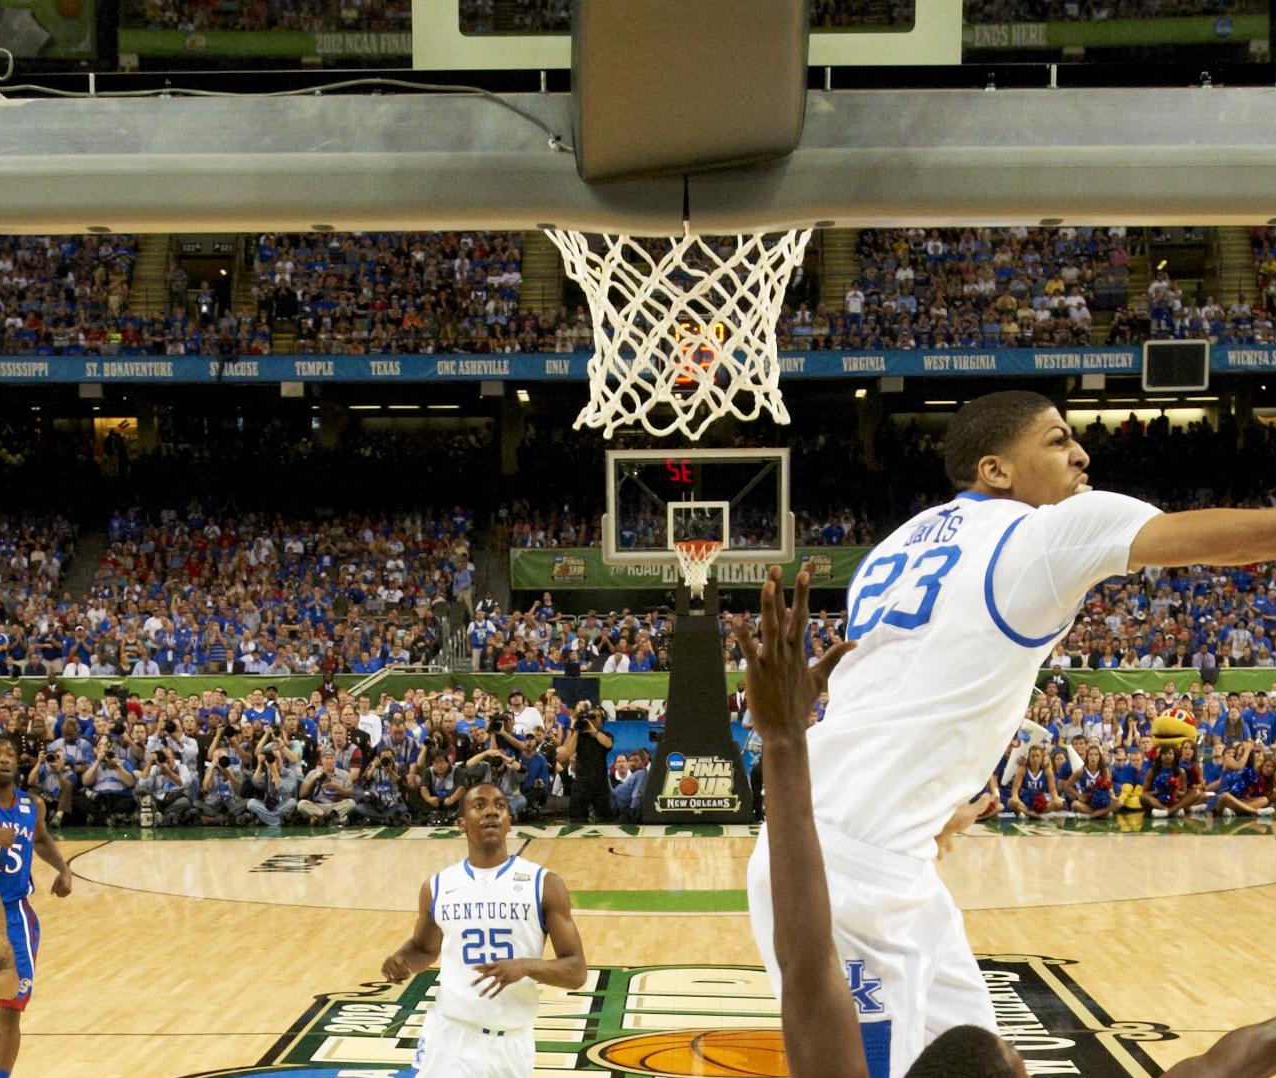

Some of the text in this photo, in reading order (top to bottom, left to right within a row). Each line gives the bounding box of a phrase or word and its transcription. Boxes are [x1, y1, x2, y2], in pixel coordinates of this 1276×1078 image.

[842, 356, 886, 372] VIRGINIA
[923, 354, 997, 371] WEST VIRGINIA
[1034, 352, 1134, 370] WESTERN KENTUCKY
[1227, 350, 1269, 366] WICHITA
[85, 361, 174, 378] ST. BONAVENTURE
[295, 361, 334, 377] TEMPLE
[370, 361, 401, 377] TEXAS
[458, 359, 510, 375] ASHEVILLE
[847, 544, 963, 641] 23
[683, 758, 734, 777] FINAL
[666, 798, 731, 809] NEW ORLEANS
[440, 901, 532, 922] KENTUCKY
[461, 927, 514, 965] 25
[323, 1002, 404, 1035] 2012
